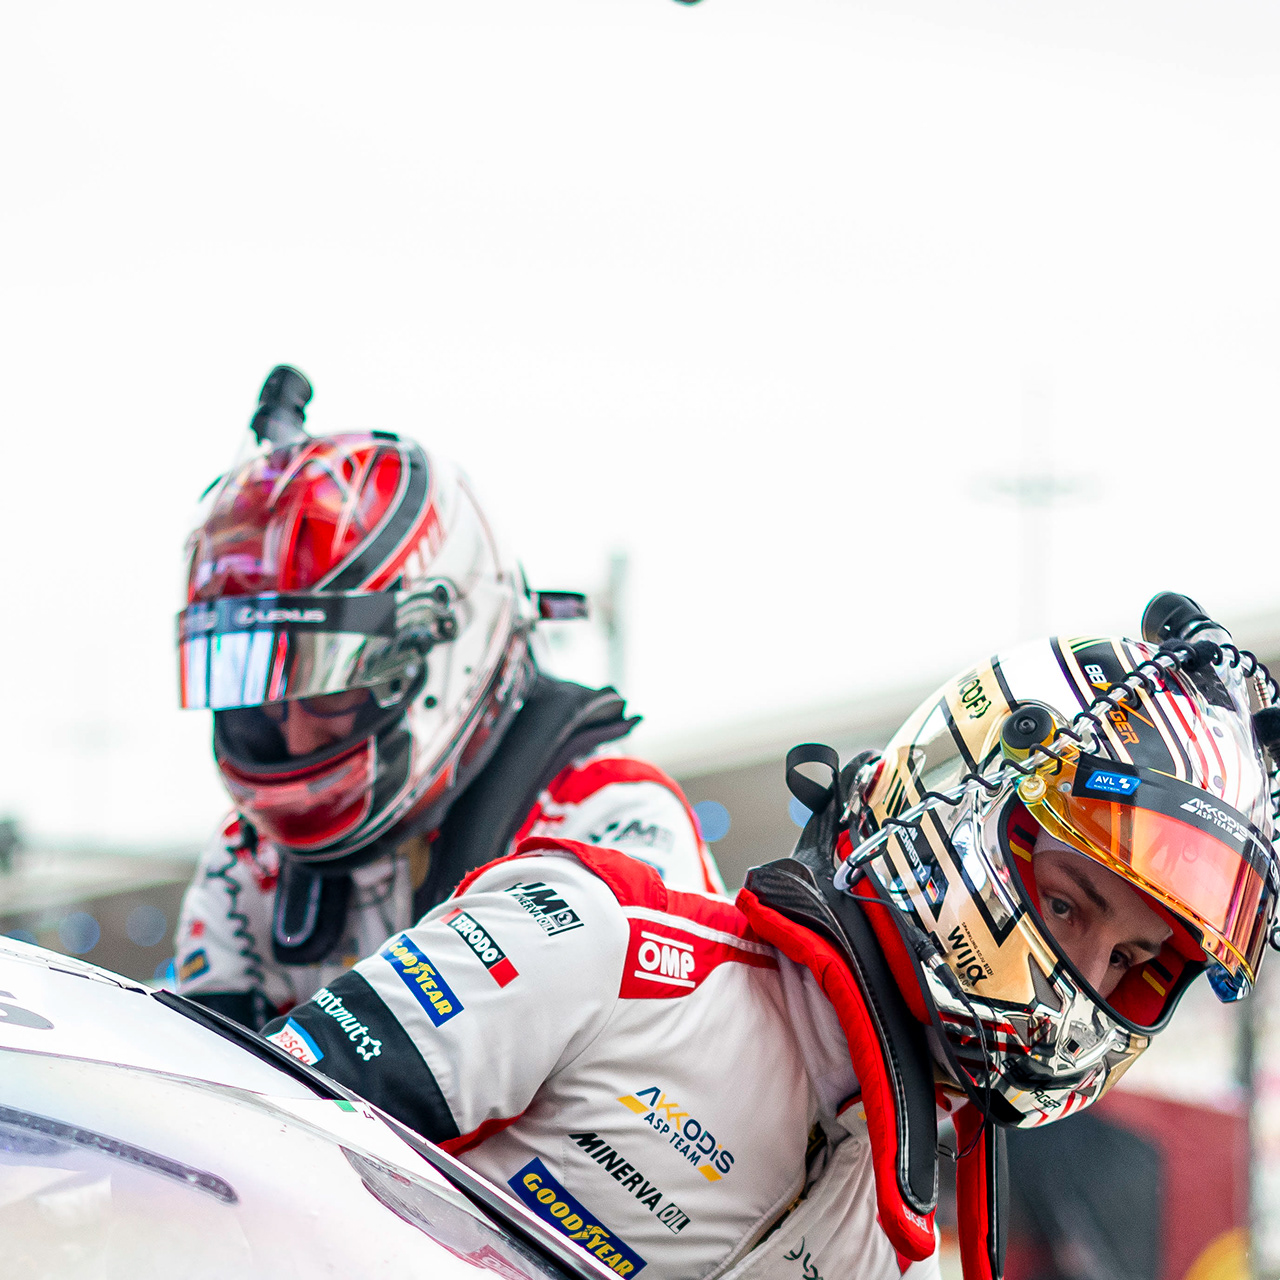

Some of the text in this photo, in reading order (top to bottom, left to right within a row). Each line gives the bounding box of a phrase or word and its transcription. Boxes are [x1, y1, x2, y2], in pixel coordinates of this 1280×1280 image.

[1095, 774, 1116, 787] AVL
[1195, 809, 1234, 835] ASP TEAM
[388, 941, 453, 1016] GOODYEAR
[637, 940, 696, 980] OMP
[643, 1111, 702, 1167] ASP TEAM
[567, 1131, 691, 1235] MINERVA OIL
[522, 1172, 635, 1277] GOODYEAR
